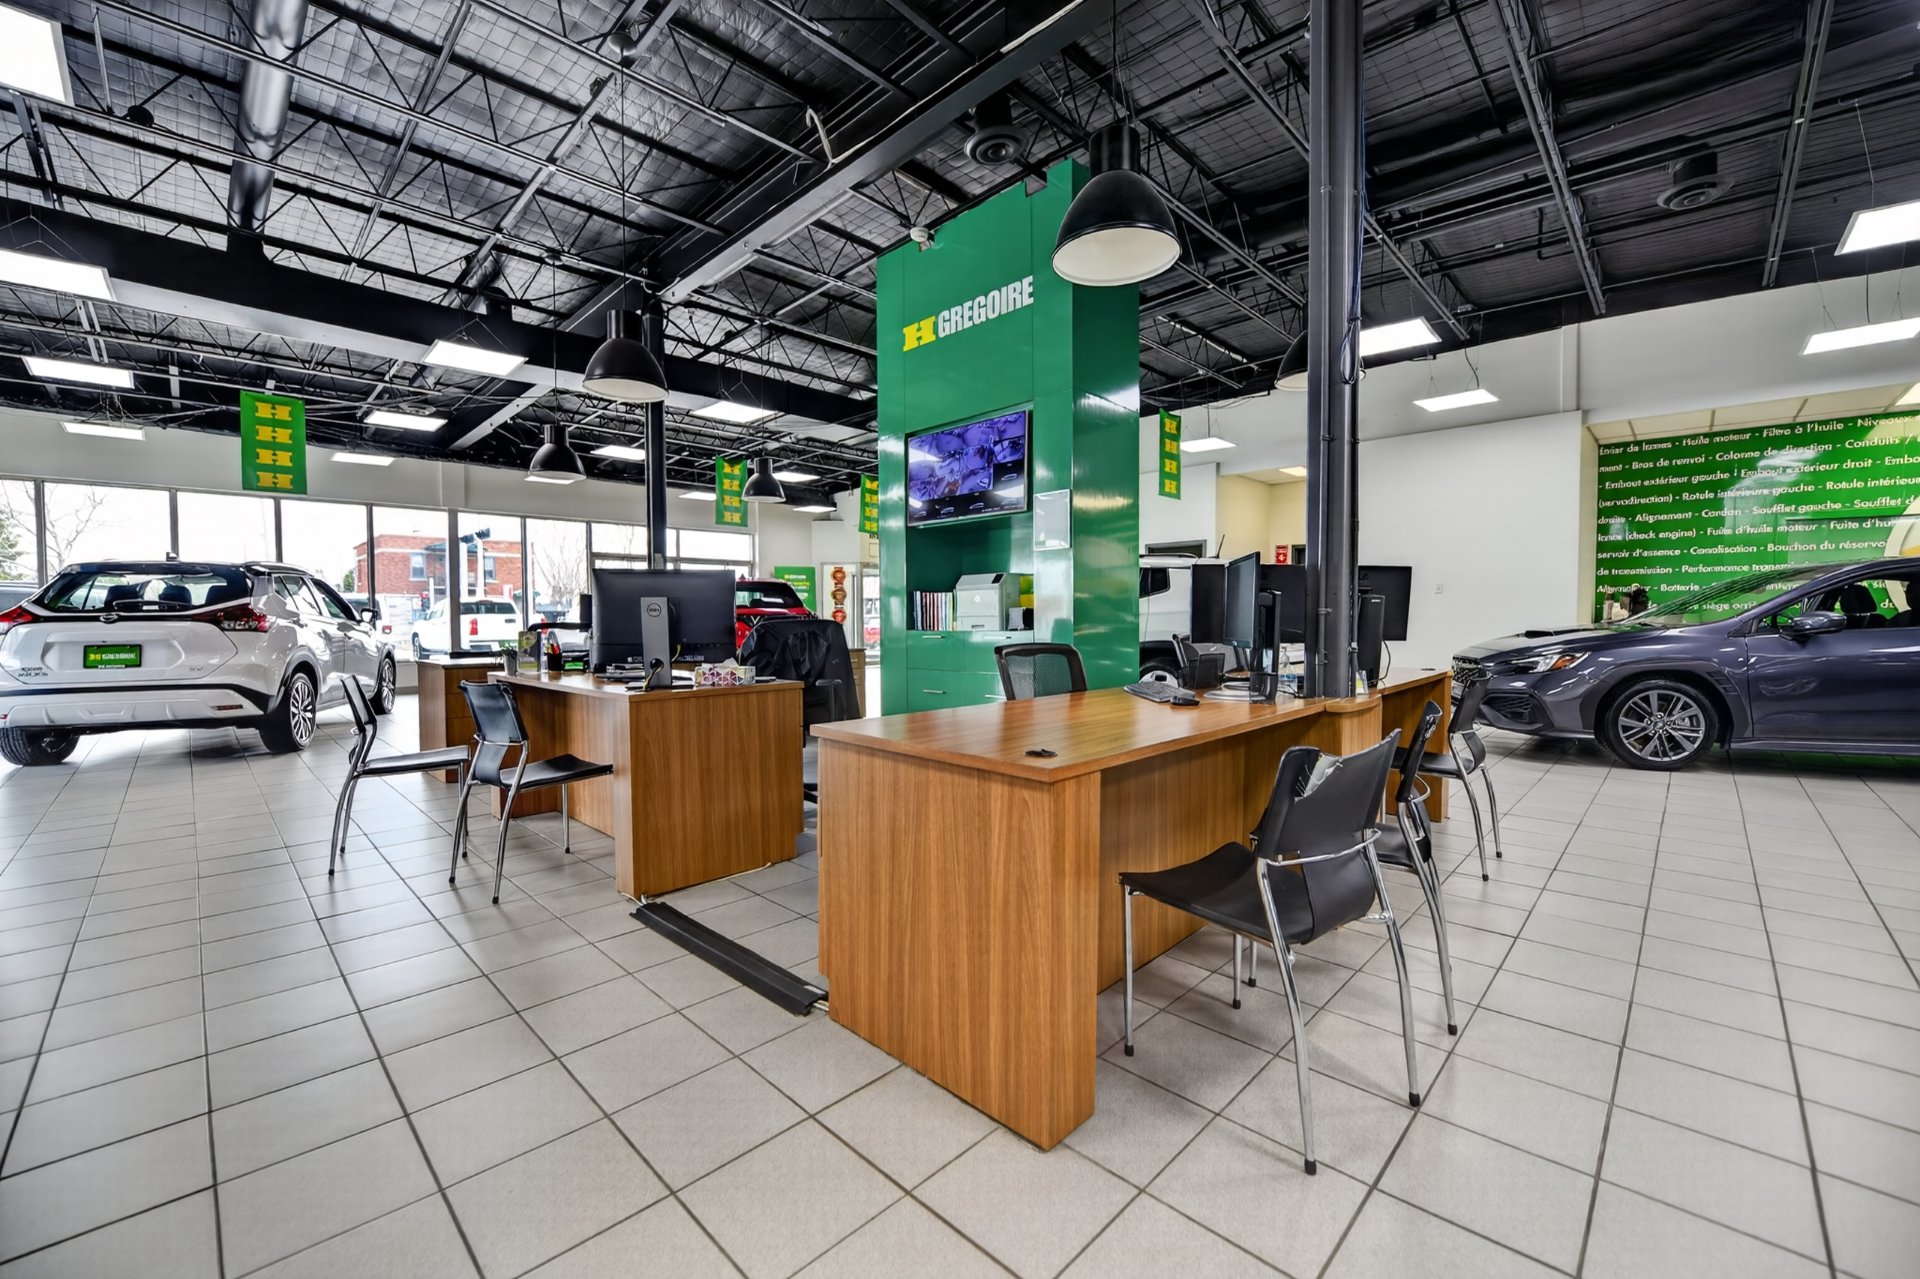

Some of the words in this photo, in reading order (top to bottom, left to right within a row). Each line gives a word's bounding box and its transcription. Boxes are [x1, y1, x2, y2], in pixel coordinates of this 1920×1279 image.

[1632, 461, 1654, 470] Bras
[1656, 458, 1670, 467] de
[1672, 454, 1706, 466] renvoi
[1715, 451, 1761, 461] Colonne
[1691, 470, 1730, 484] gauche
[1843, 458, 1873, 469] droit
[1682, 490, 1715, 501] Rotule
[1772, 483, 1815, 496] gauche
[1826, 478, 1865, 490] Rotule
[1635, 512, 1692, 523] Alignement
[1701, 508, 1742, 518] Cardan
[1752, 503, 1796, 515] Soufflet
[1798, 501, 1842, 513] gauche
[1853, 496, 1902, 508] Soufflet
[1659, 528, 1696, 540] engine)
[1707, 526, 1733, 536] Fuite
[1830, 520, 1860, 530] Fuite
[1767, 541, 1817, 552] Bouchon
[1820, 540, 1836, 550] du
[1839, 540, 1886, 550] réservo
